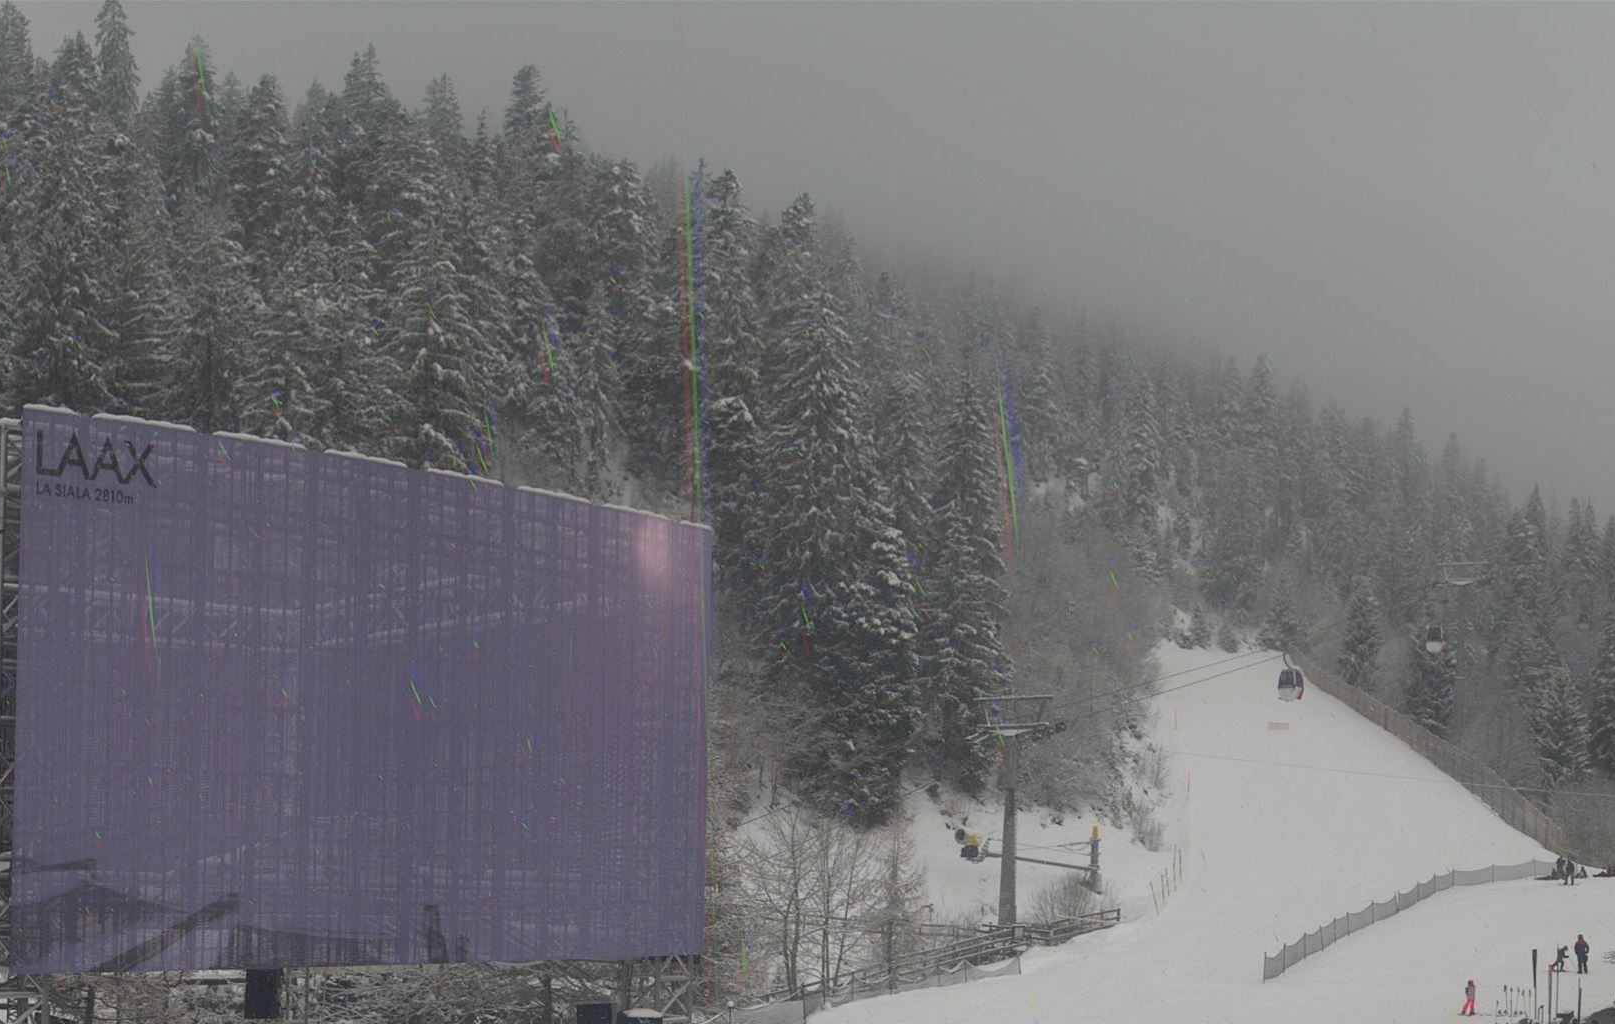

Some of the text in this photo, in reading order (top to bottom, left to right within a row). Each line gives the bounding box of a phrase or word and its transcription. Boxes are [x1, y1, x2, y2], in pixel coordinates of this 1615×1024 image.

[36, 430, 157, 489] LAAX
[36, 480, 134, 505] LA SIALA 2810m
